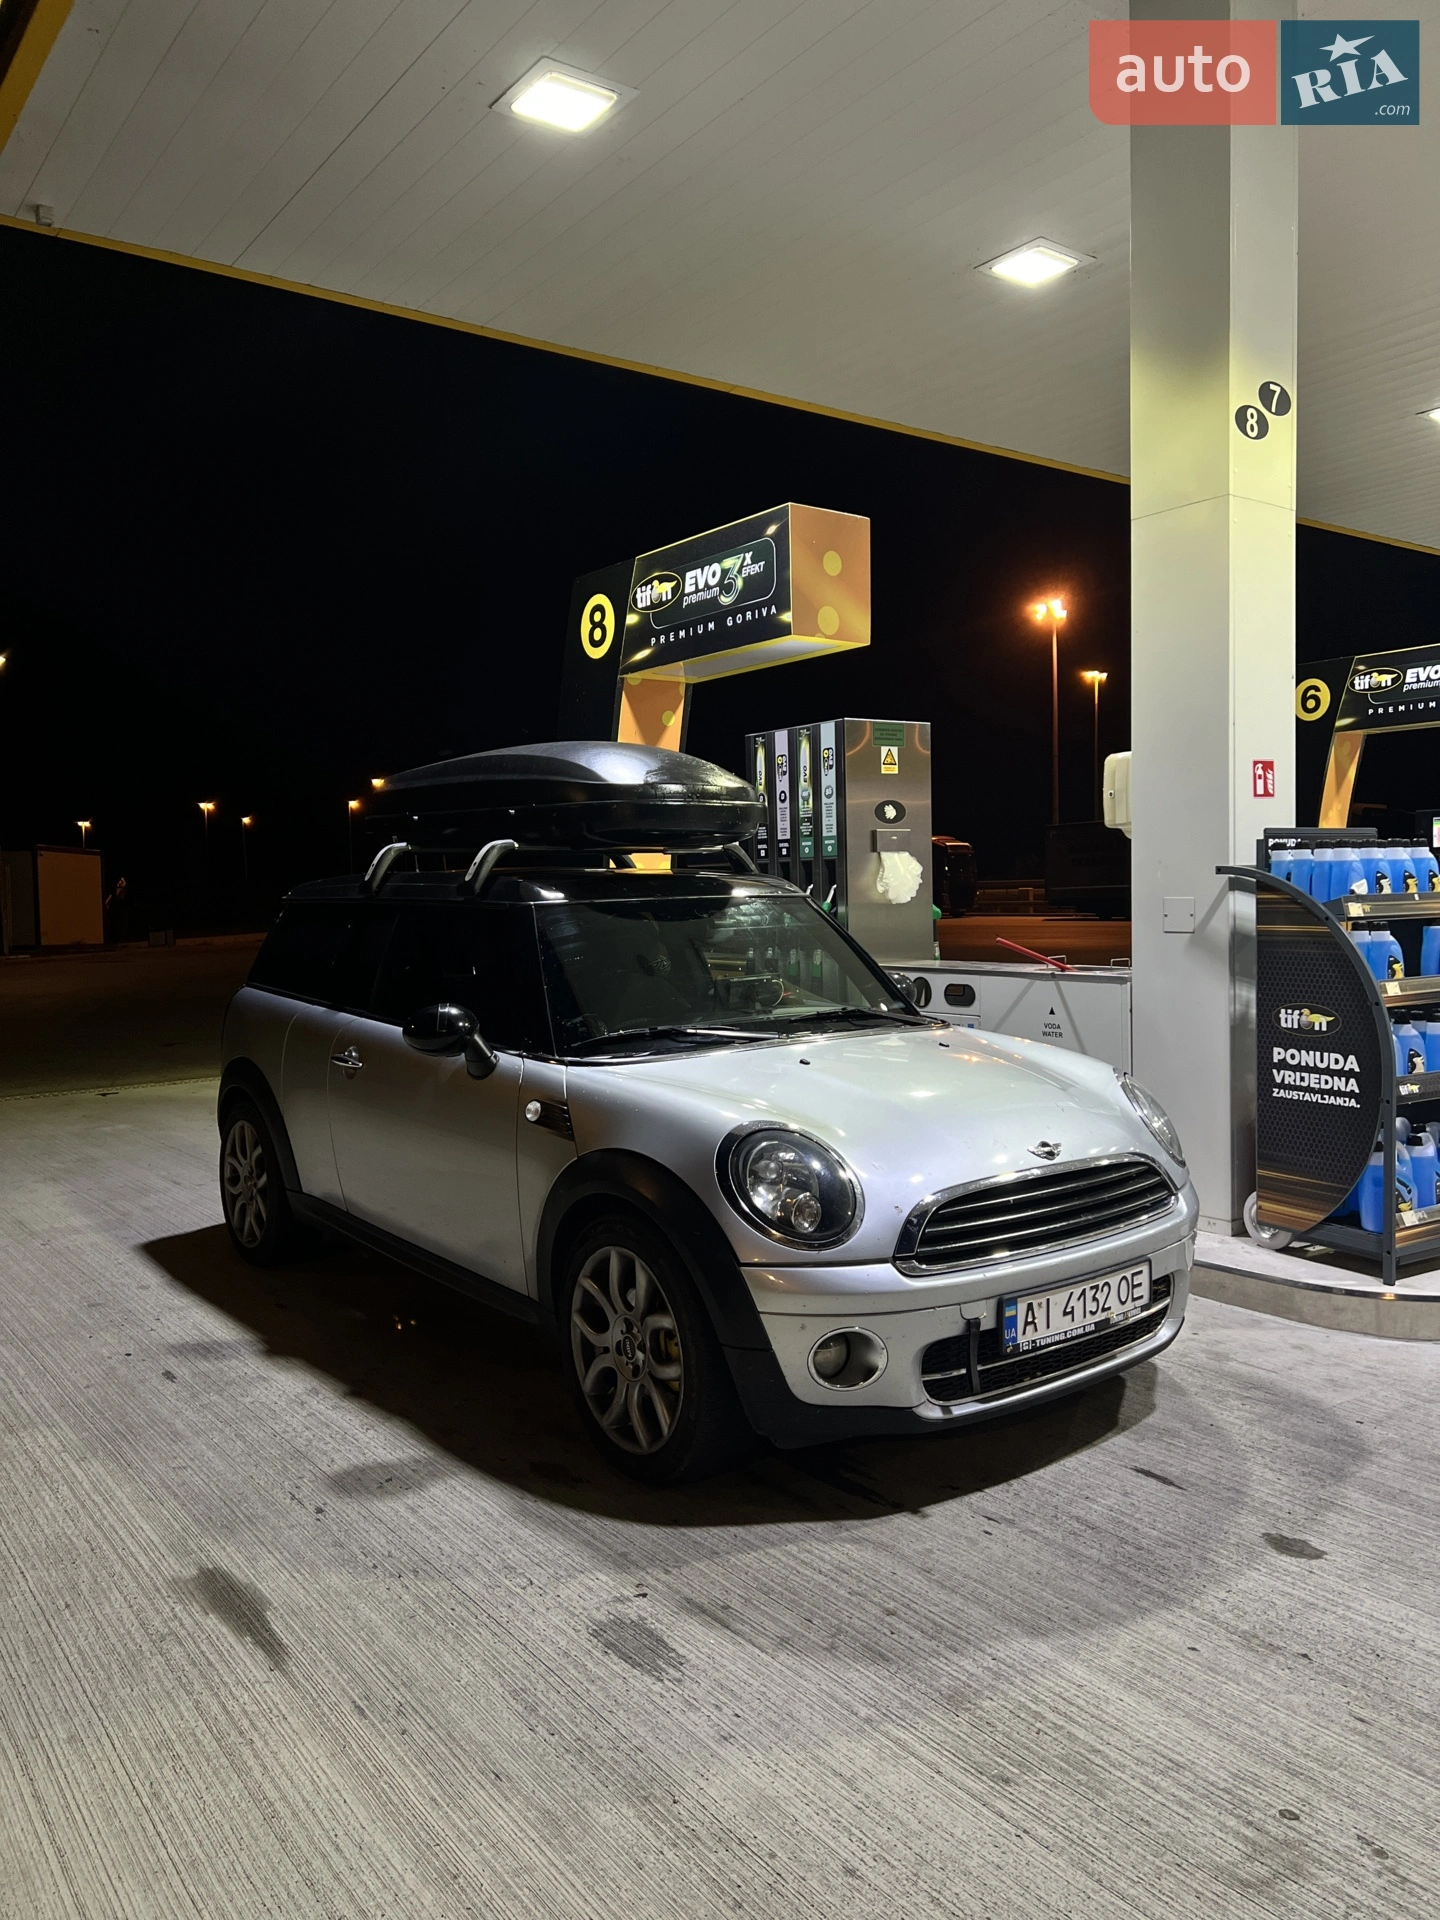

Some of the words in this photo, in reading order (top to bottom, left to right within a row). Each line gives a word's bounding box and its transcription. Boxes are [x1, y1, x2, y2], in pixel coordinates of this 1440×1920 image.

[1269, 383, 1282, 413] 7
[1246, 407, 1259, 438] 8
[684, 562, 721, 594] EVO
[741, 560, 766, 578] EFEKT
[682, 586, 720, 609] premium
[588, 603, 608, 651] 8
[650, 622, 715, 647] PREMIUM
[726, 604, 778, 627] GORIVA
[1300, 684, 1322, 715] 6
[1368, 701, 1436, 715] PREMIUM
[1044, 1022, 1061, 1030] VODA
[1272, 1047, 1361, 1073] PONUDA
[1272, 1069, 1360, 1094] VRIJEDNA
[1272, 1088, 1361, 1109] ZAUSTAVLJANJA.
[1022, 1297, 1051, 1336] AI
[1062, 1281, 1112, 1323] 4132
[1117, 1269, 1144, 1306] OE
[1004, 1329, 1016, 1340] UA
